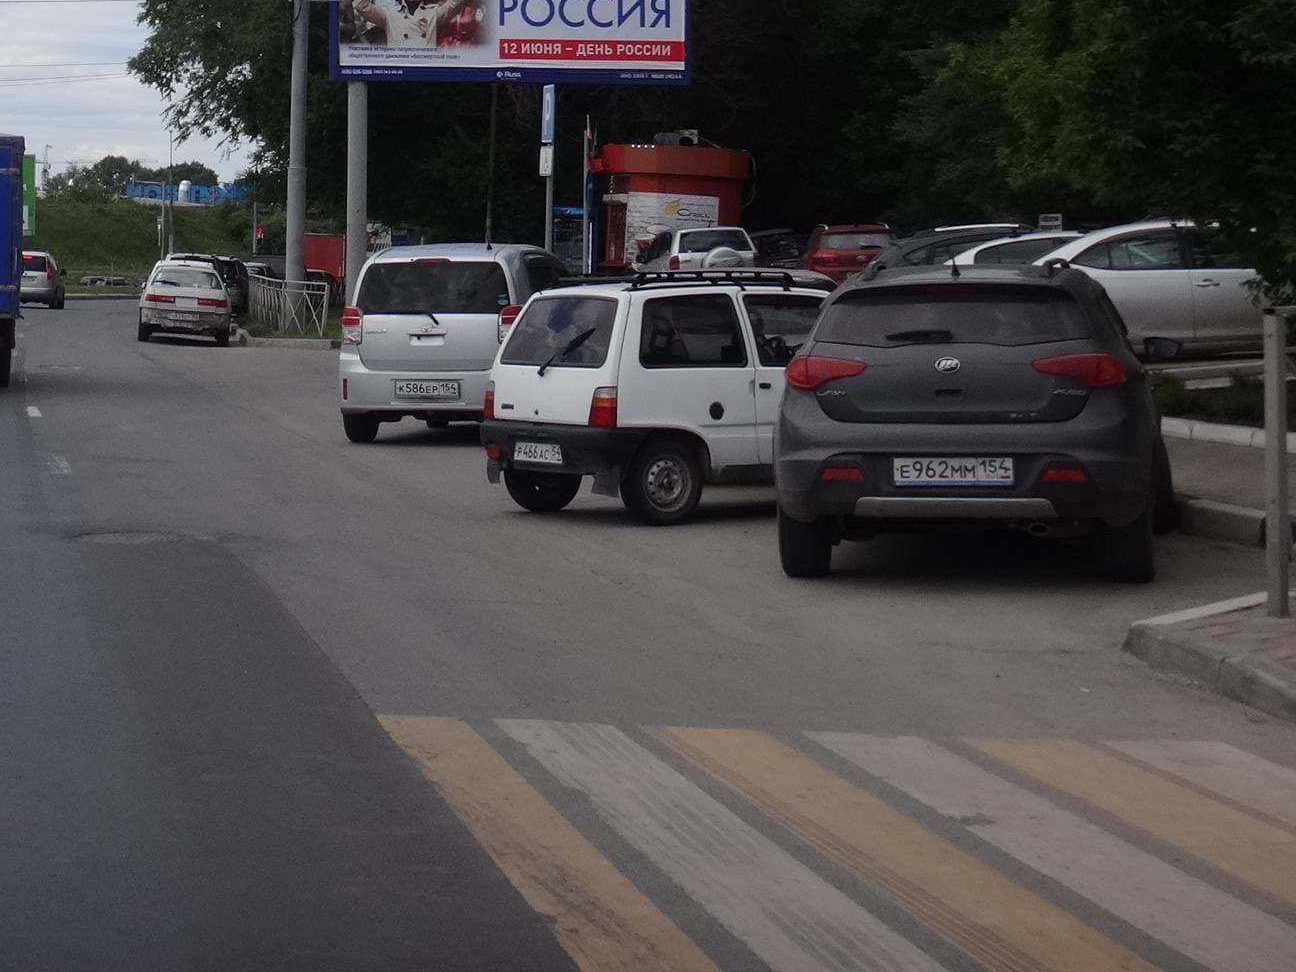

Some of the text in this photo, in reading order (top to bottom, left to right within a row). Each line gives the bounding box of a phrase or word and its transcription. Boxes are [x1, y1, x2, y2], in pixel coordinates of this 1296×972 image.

[502, 43, 518, 54] 12
[521, 43, 562, 55] ИЮНЯ
[576, 44, 613, 56] ДЕНЬ
[617, 44, 671, 56] РОССИИ
[398, 381, 438, 394] К586ЕР
[900, 460, 1011, 479] Е962ММ 154
